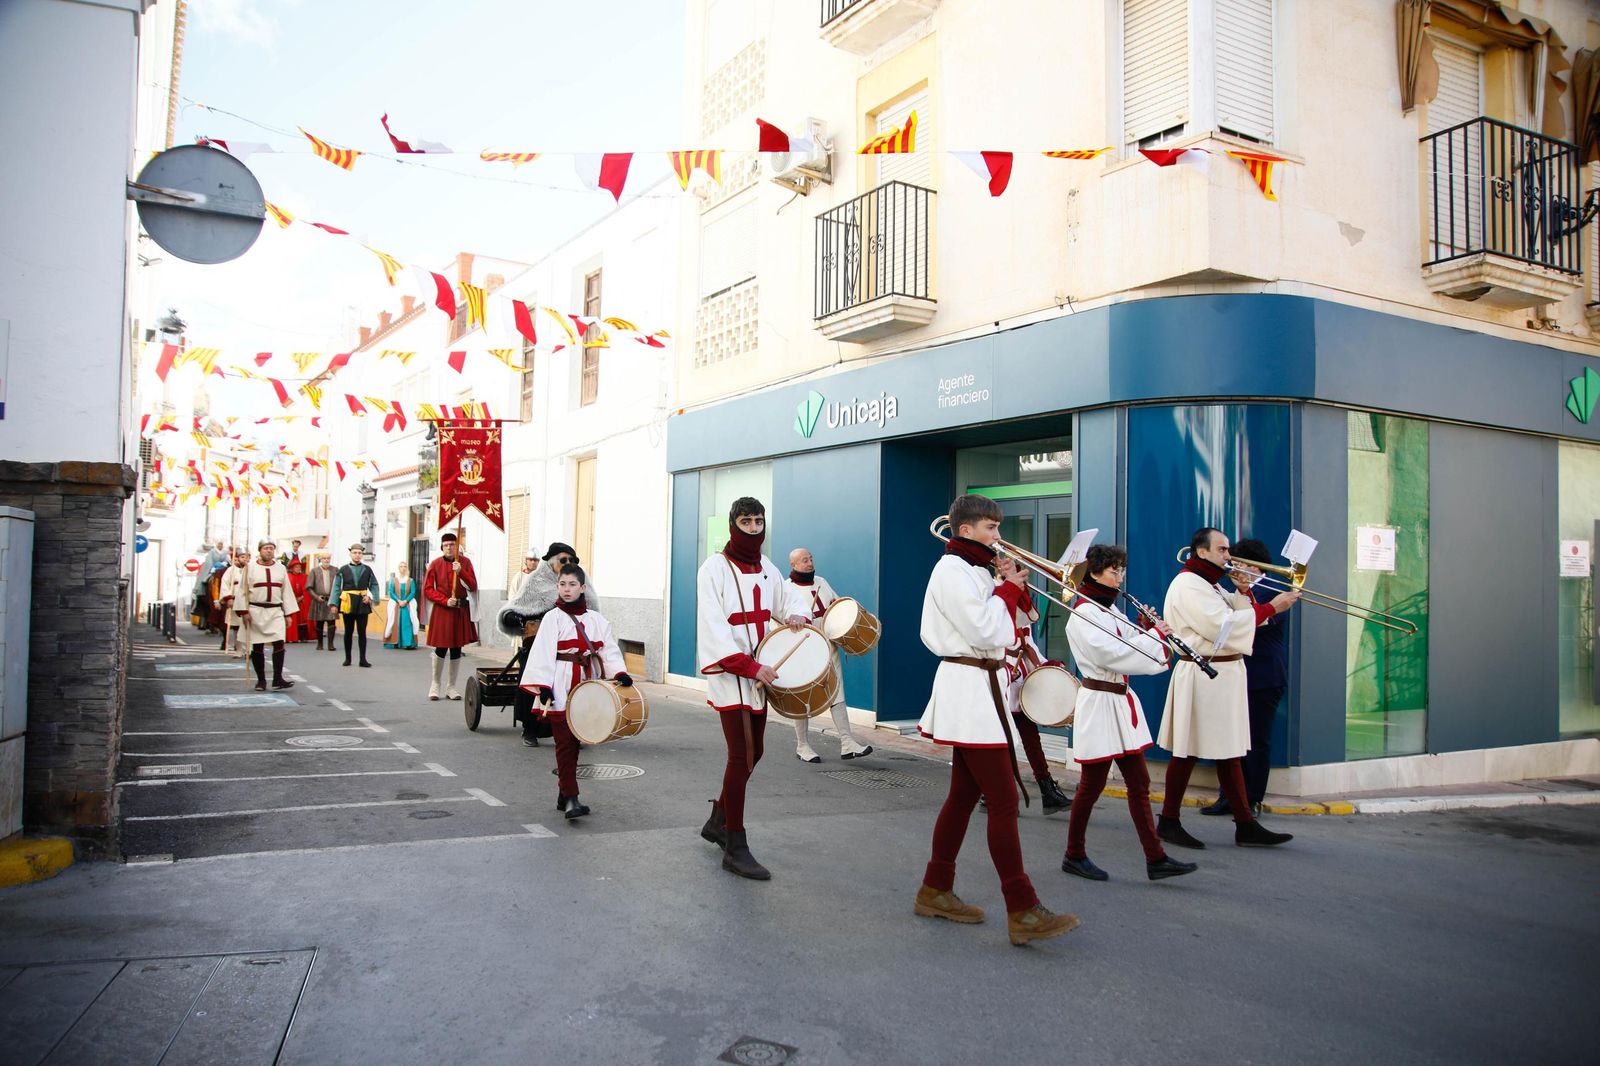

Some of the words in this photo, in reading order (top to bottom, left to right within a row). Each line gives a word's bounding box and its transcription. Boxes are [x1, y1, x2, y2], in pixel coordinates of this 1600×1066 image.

[937, 373, 975, 395] Agente
[938, 389, 990, 409] financiero
[826, 392, 899, 429] Unicaja
